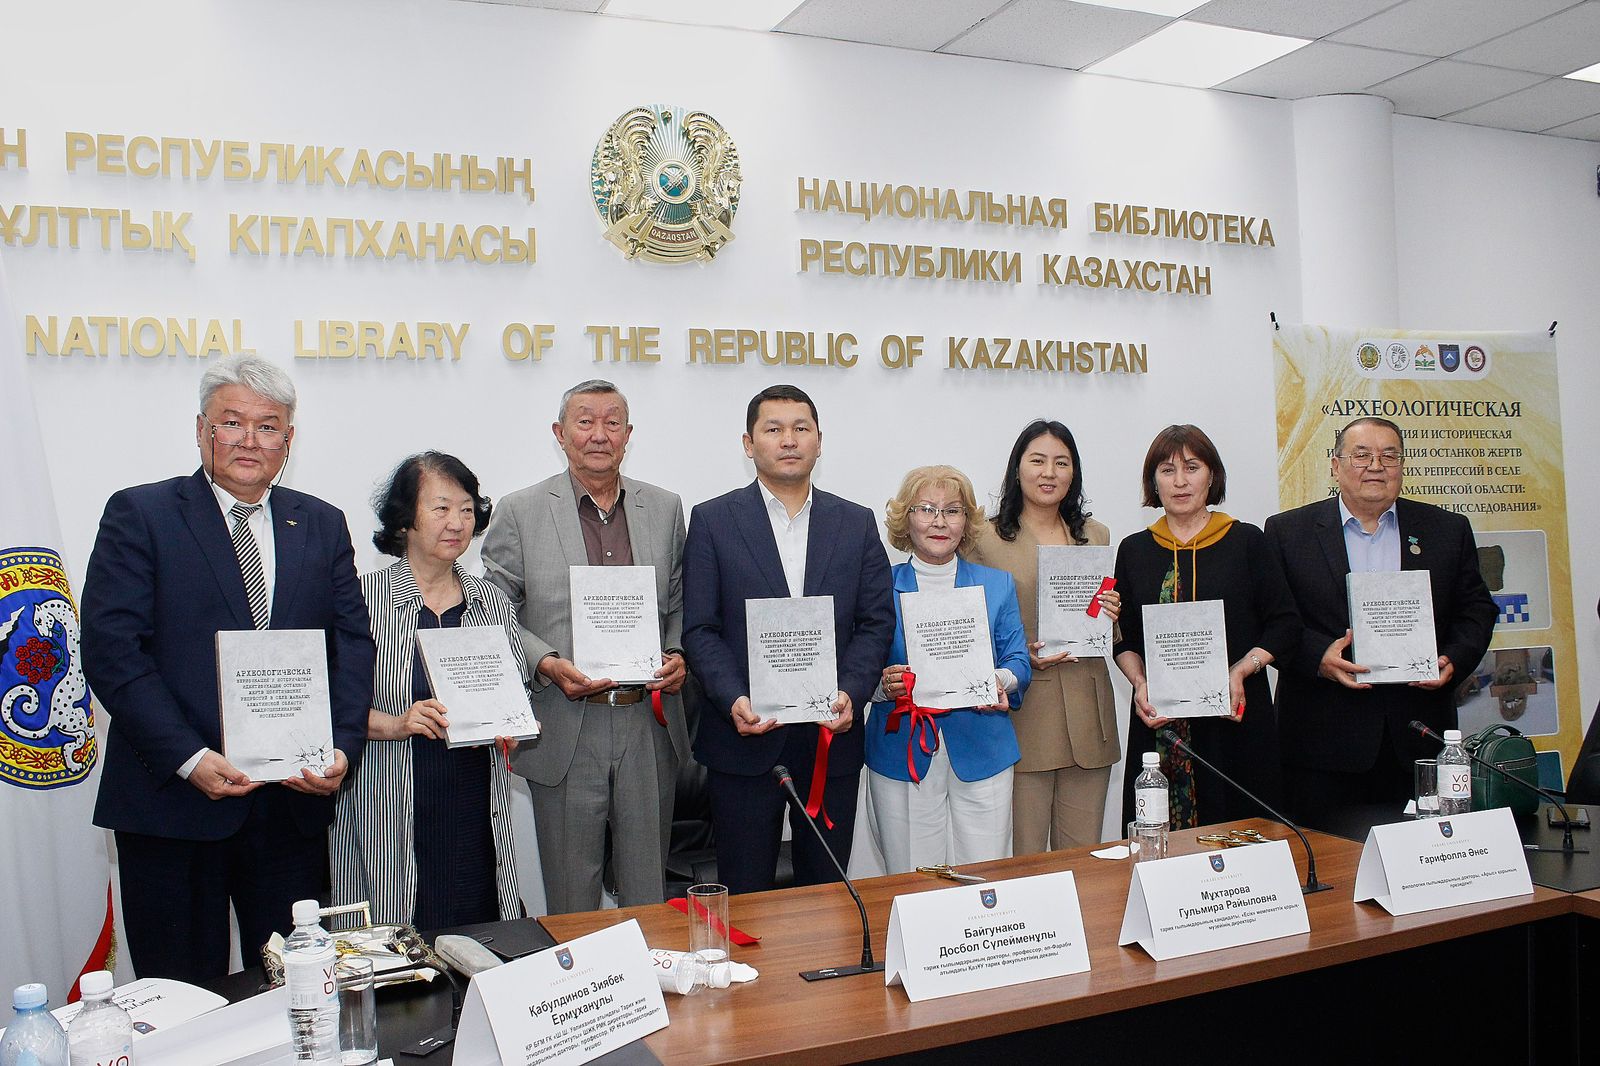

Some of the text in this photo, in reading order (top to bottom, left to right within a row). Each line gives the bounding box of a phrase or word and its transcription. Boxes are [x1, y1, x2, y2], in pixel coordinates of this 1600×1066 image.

[65, 131, 535, 202] РЕСПУБЛИКАСЫНЫҢ
[798, 177, 1275, 247] НАЦИОНАЛЬНАЯ БИБЛИОТЕКА
[229, 214, 537, 263] КІТАПХАНАСЫ
[651, 229, 697, 241] QAZAQSTAN
[799, 239, 1212, 296] РЕСПУБЛИКИ КАЗАХСТАН
[26, 315, 1148, 374] NATIONAL LIBRARY OF THE REPUBLIC OF KAZAKHSTAN
[1321, 399, 1522, 418] «АРХЕОЛОГИЧЕСКАЯ
[1421, 429, 1428, 439] И
[1431, 429, 1512, 439] ИСТОРИЧЕСКАЯ
[1429, 448, 1485, 458] ОСТАНКОВ
[1488, 448, 1522, 458] ЖЕРТВ
[1424, 464, 1484, 476] РЕПРЕССИЙ
[1487, 466, 1493, 476] В
[1495, 466, 1521, 476] СЕЛЕ
[1400, 483, 1526, 495] ЛМАТИНСКОЙ ОБЛАСТИ:
[1452, 502, 1542, 514] ИССЛЕДОВАНИЯ»
[236, 668, 312, 677] АРХЕОЛОГИЧЕСКАЯ
[1452, 773, 1469, 783] VO
[1419, 847, 1488, 865] Ғарифолла Әнес
[1178, 903, 1224, 919] Гульмира
[964, 922, 1025, 938] Байгунаков
[939, 930, 1056, 959] Досбол Сүлейменұлы
[528, 973, 624, 1018] Қабулдинов Зиябек
[551, 994, 613, 1025] Ермұханұлы
